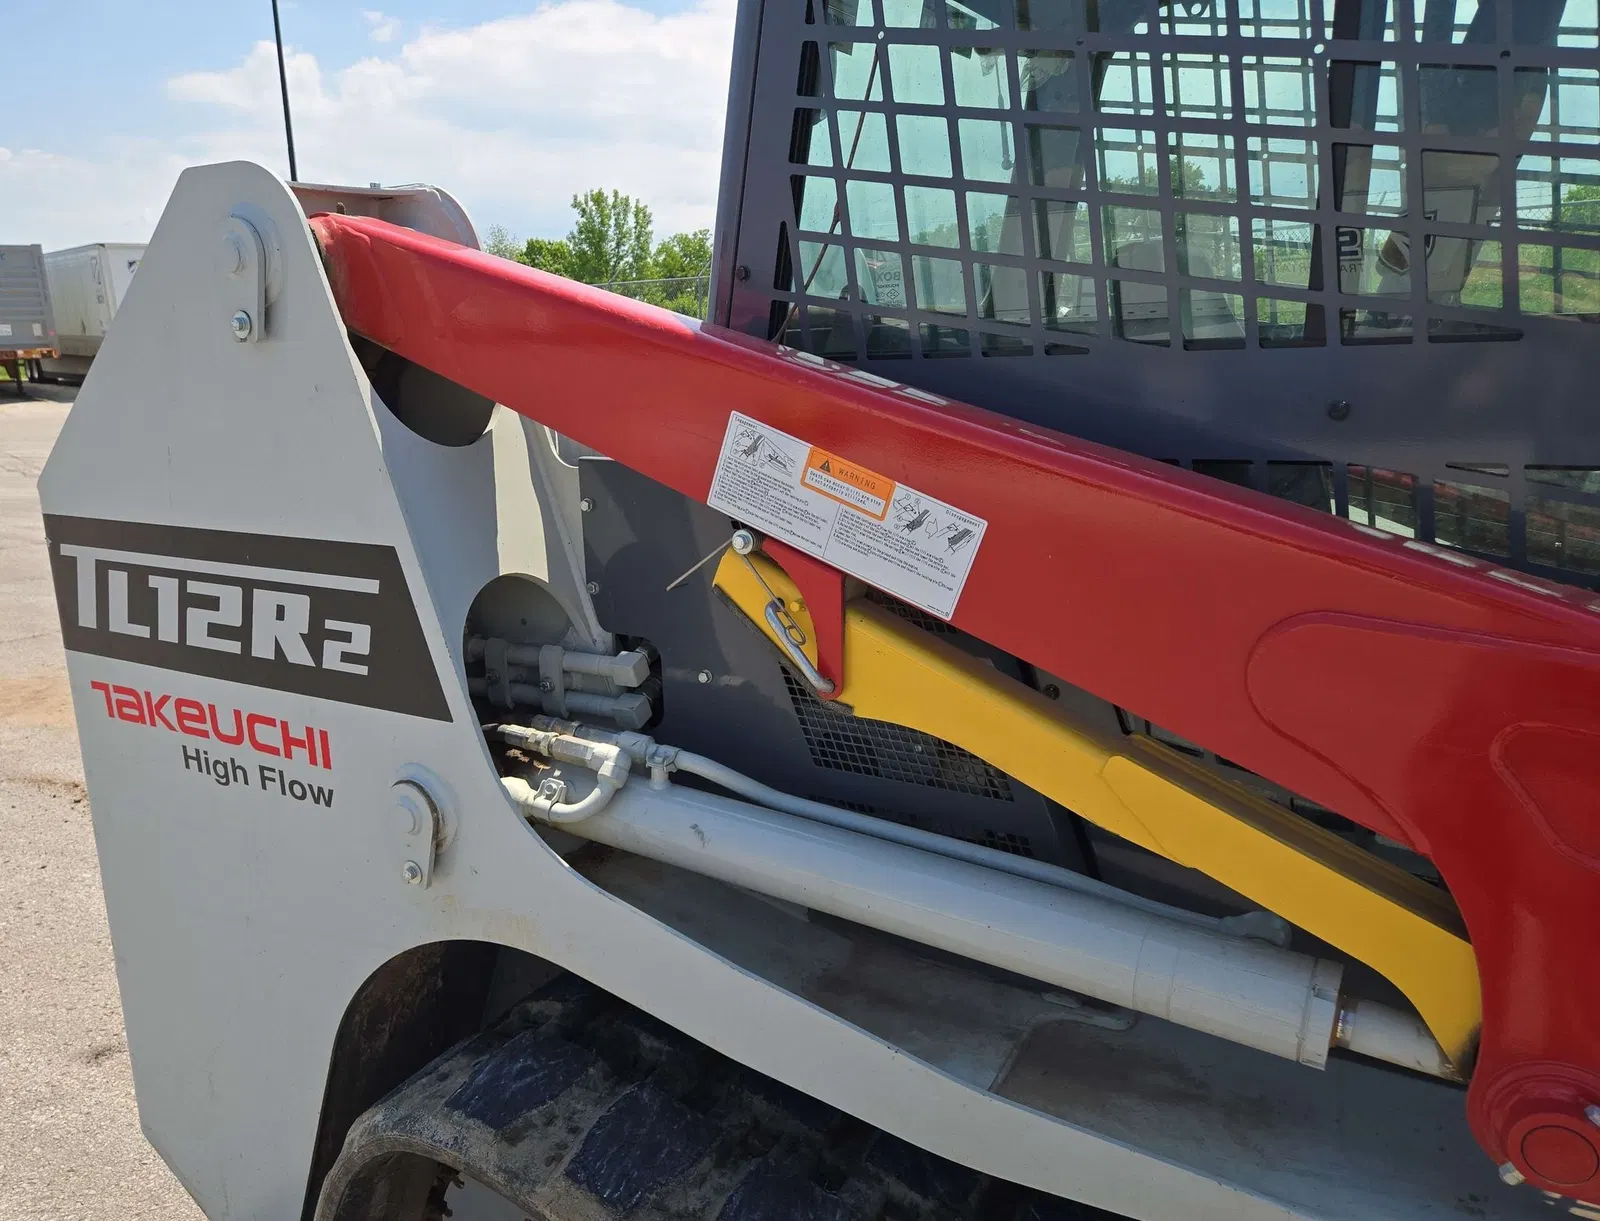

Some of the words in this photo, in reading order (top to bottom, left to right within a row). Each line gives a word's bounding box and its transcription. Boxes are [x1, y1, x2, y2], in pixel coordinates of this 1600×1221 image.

[809, 469, 823, 480] Death
[837, 466, 877, 490] WARNING
[181, 744, 249, 787] High
[258, 764, 334, 808] Flow
